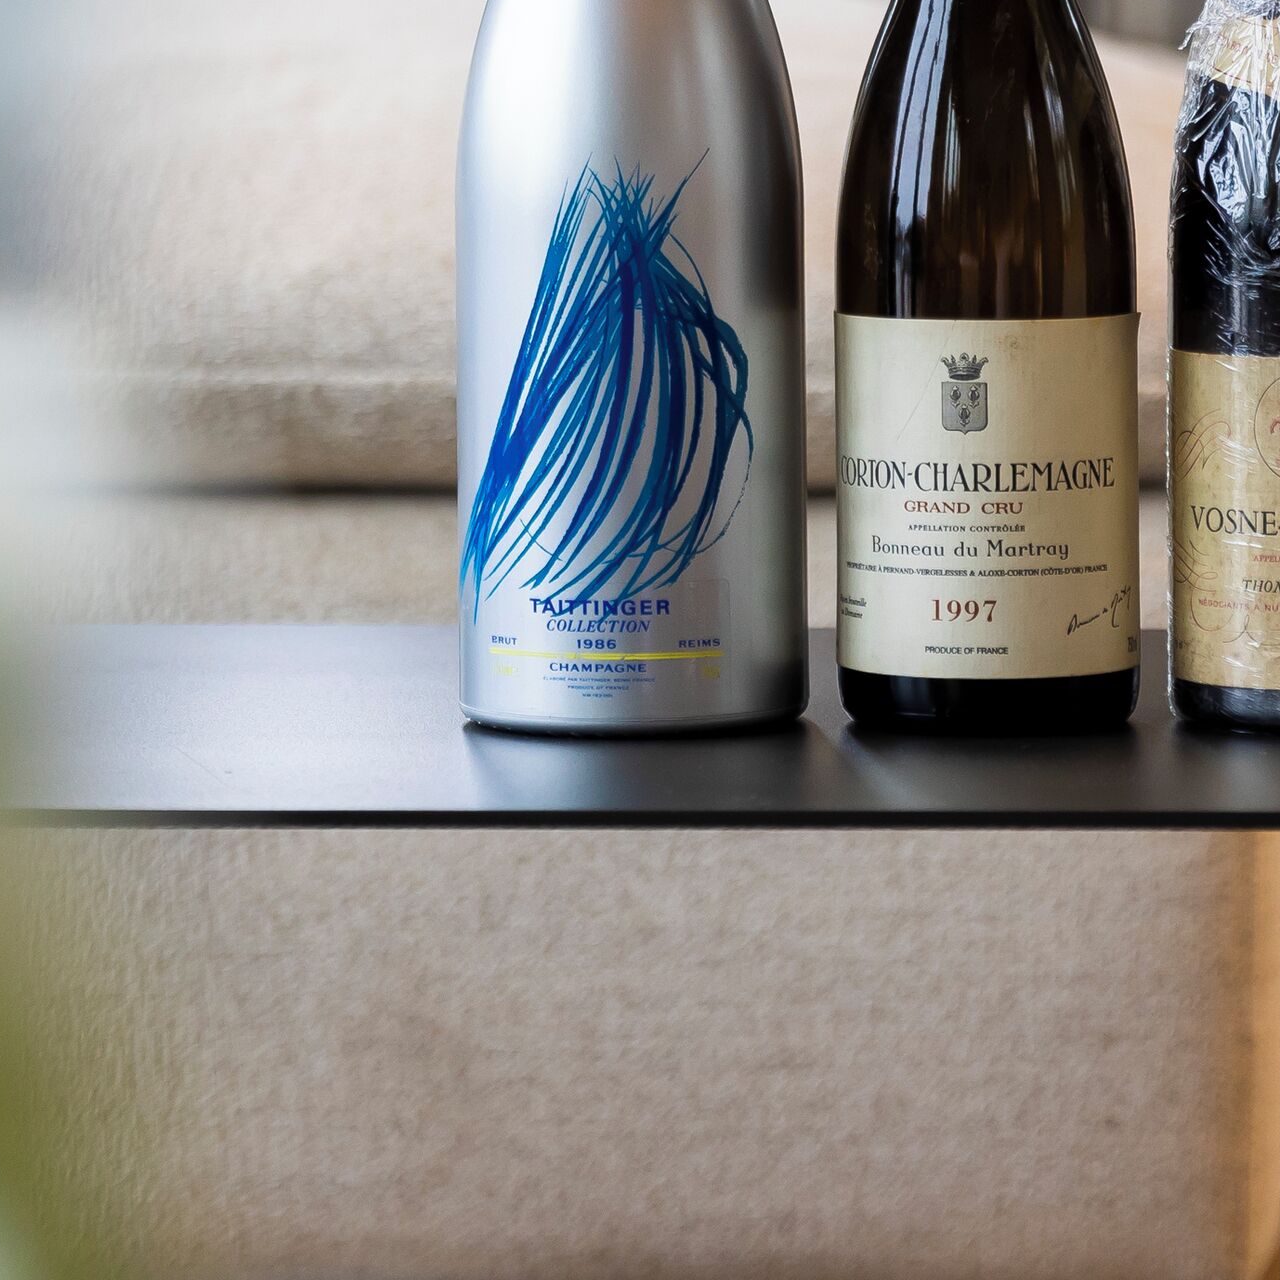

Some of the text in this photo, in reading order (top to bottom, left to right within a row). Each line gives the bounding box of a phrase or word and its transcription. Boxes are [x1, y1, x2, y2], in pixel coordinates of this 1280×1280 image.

[841, 456, 1116, 493] CORTON-CHARLEMAGNE
[904, 500, 1023, 515] GRAND CRU
[908, 523, 1026, 533] APPELLATION CONTRÔLÉE
[872, 535, 1070, 561] Bonneau du Martray
[883, 566, 967, 577] PERNAND-VERGELESSES
[969, 569, 976, 577] &
[978, 569, 1039, 577] ALOXE-CORTON
[1085, 564, 1108, 573] FRANCE
[529, 598, 670, 617] TAITTINGER
[931, 599, 998, 622] 1997
[546, 619, 650, 633] COLLECTION
[491, 636, 517, 645] BRUT
[576, 639, 617, 650] 1986
[678, 638, 721, 649] REIMS
[925, 646, 1009, 655] PRODUCE OF FRANCE
[549, 662, 647, 673] CHAMPAGNE
